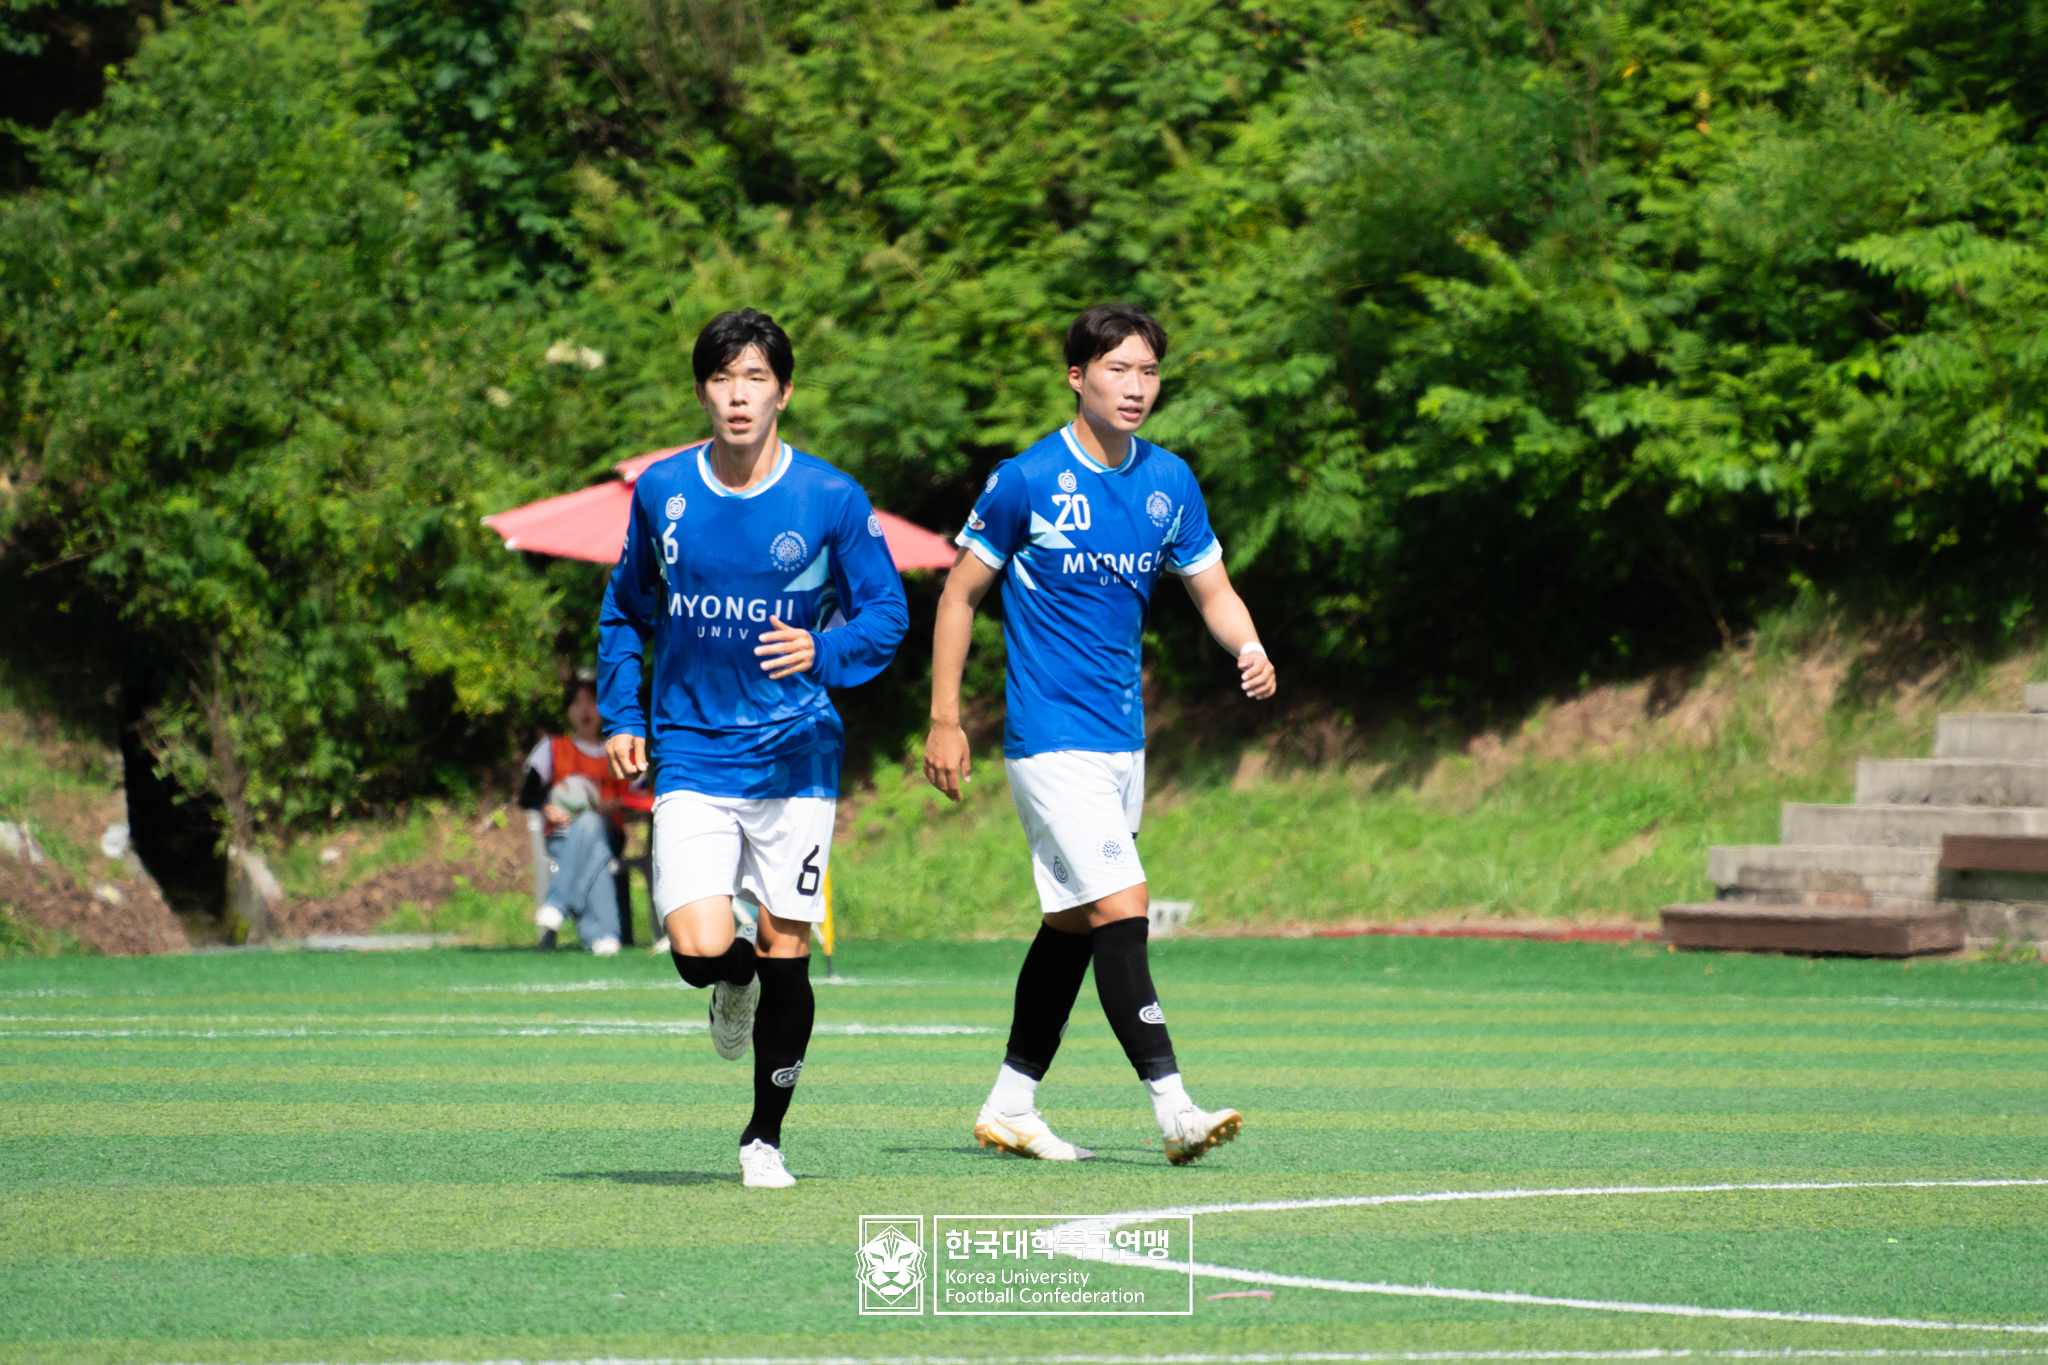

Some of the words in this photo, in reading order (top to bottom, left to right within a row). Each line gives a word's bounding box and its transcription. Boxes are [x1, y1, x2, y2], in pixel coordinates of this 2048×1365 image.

[1051, 494, 1091, 531] 20
[662, 521, 679, 565] 6
[1099, 575, 1138, 590] UNV
[667, 592, 794, 622] MYONGJI
[696, 625, 749, 640] UNIV
[796, 845, 820, 896] 6
